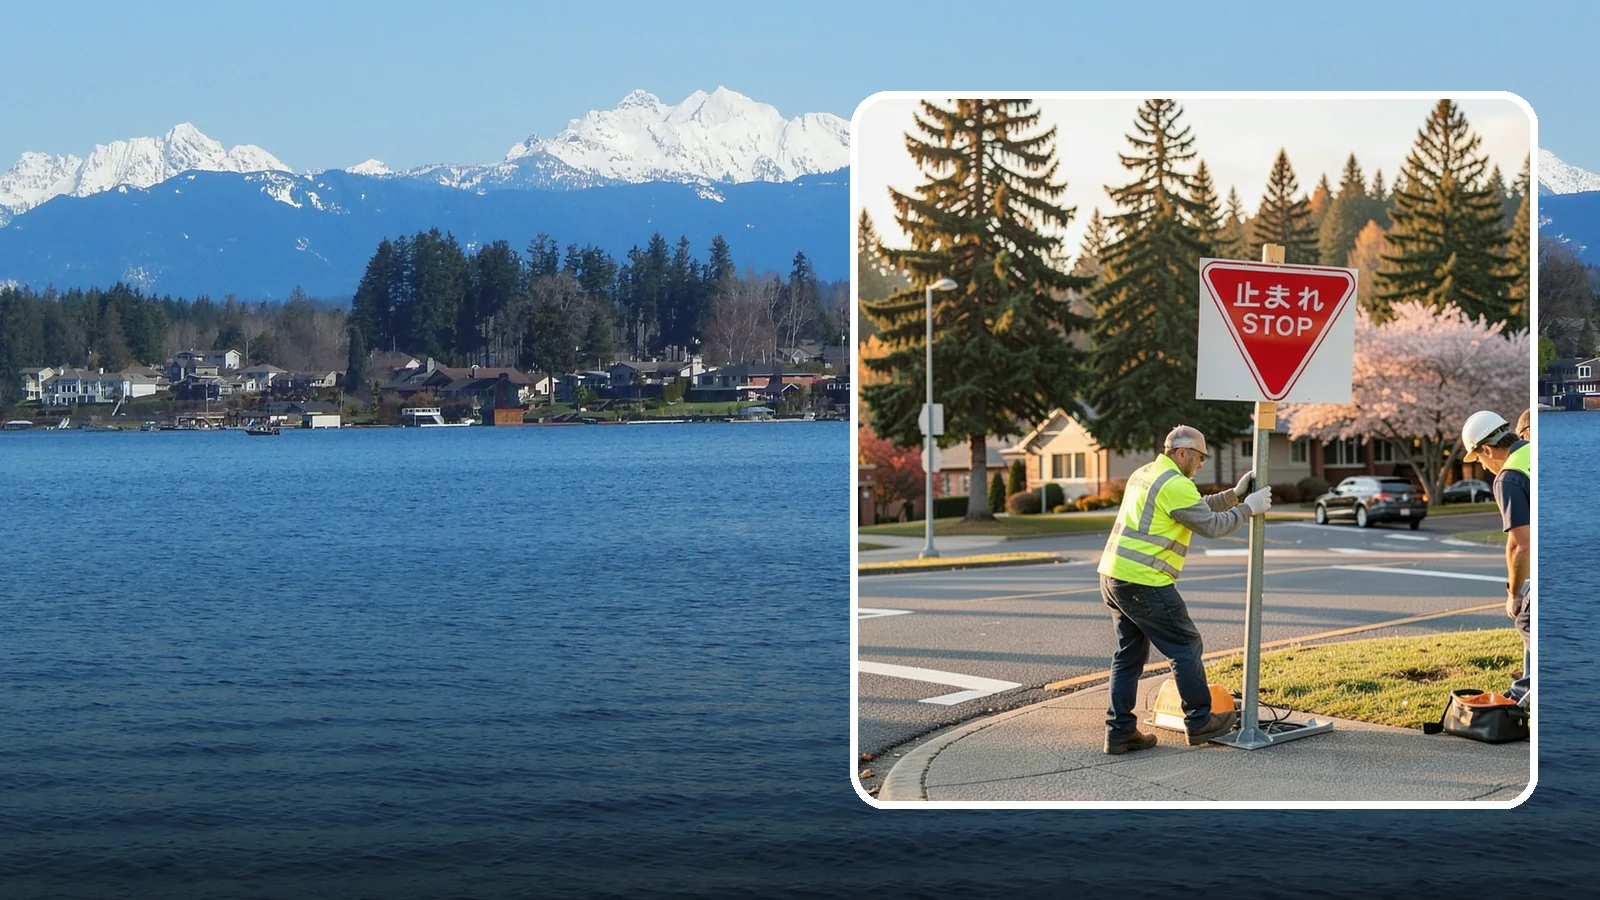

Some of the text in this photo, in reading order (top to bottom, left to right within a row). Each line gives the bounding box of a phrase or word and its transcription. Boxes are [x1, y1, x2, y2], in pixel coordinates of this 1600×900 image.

[1233, 281, 1324, 312] 止まれ
[1242, 312, 1313, 337] STOP
